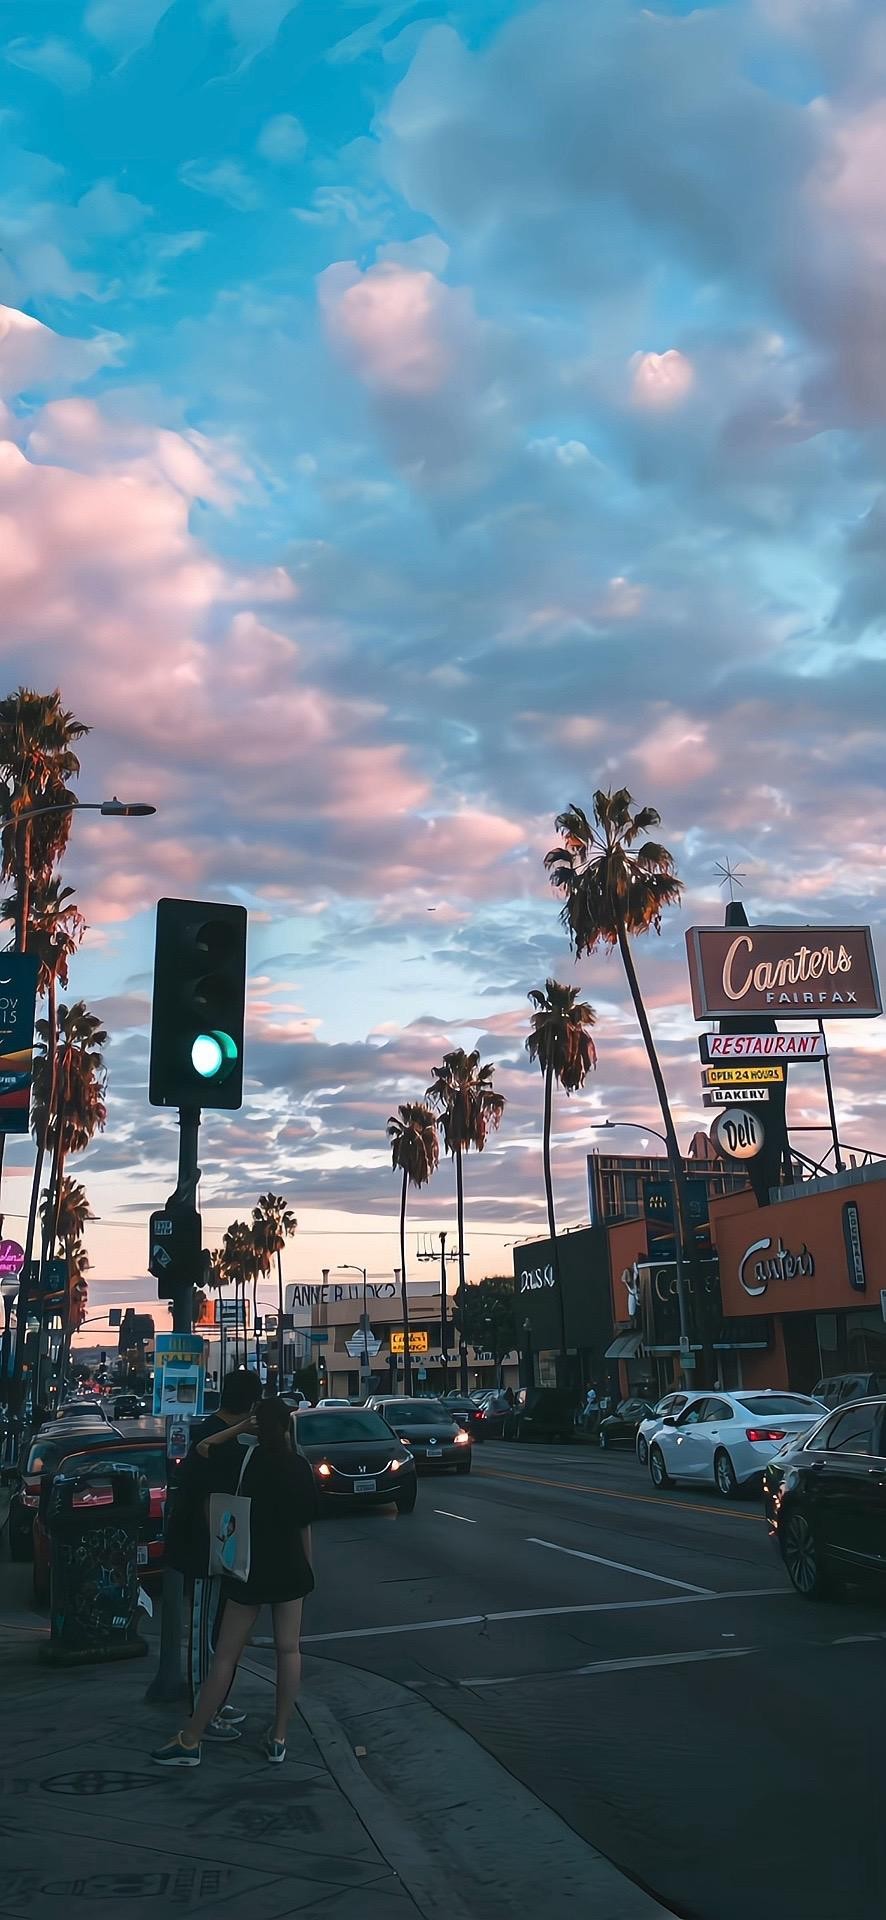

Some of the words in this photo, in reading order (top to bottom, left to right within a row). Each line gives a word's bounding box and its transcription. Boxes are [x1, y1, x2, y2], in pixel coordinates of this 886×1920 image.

[766, 991, 857, 1004] FAIRFAX
[711, 1035, 820, 1055] RESTAURANT
[711, 1071, 733, 1081] OPEN
[735, 1070, 749, 1080] 24
[750, 1069, 779, 1080] HOURS
[715, 1090, 765, 1100] BAKERY
[723, 1113, 757, 1151] Deli
